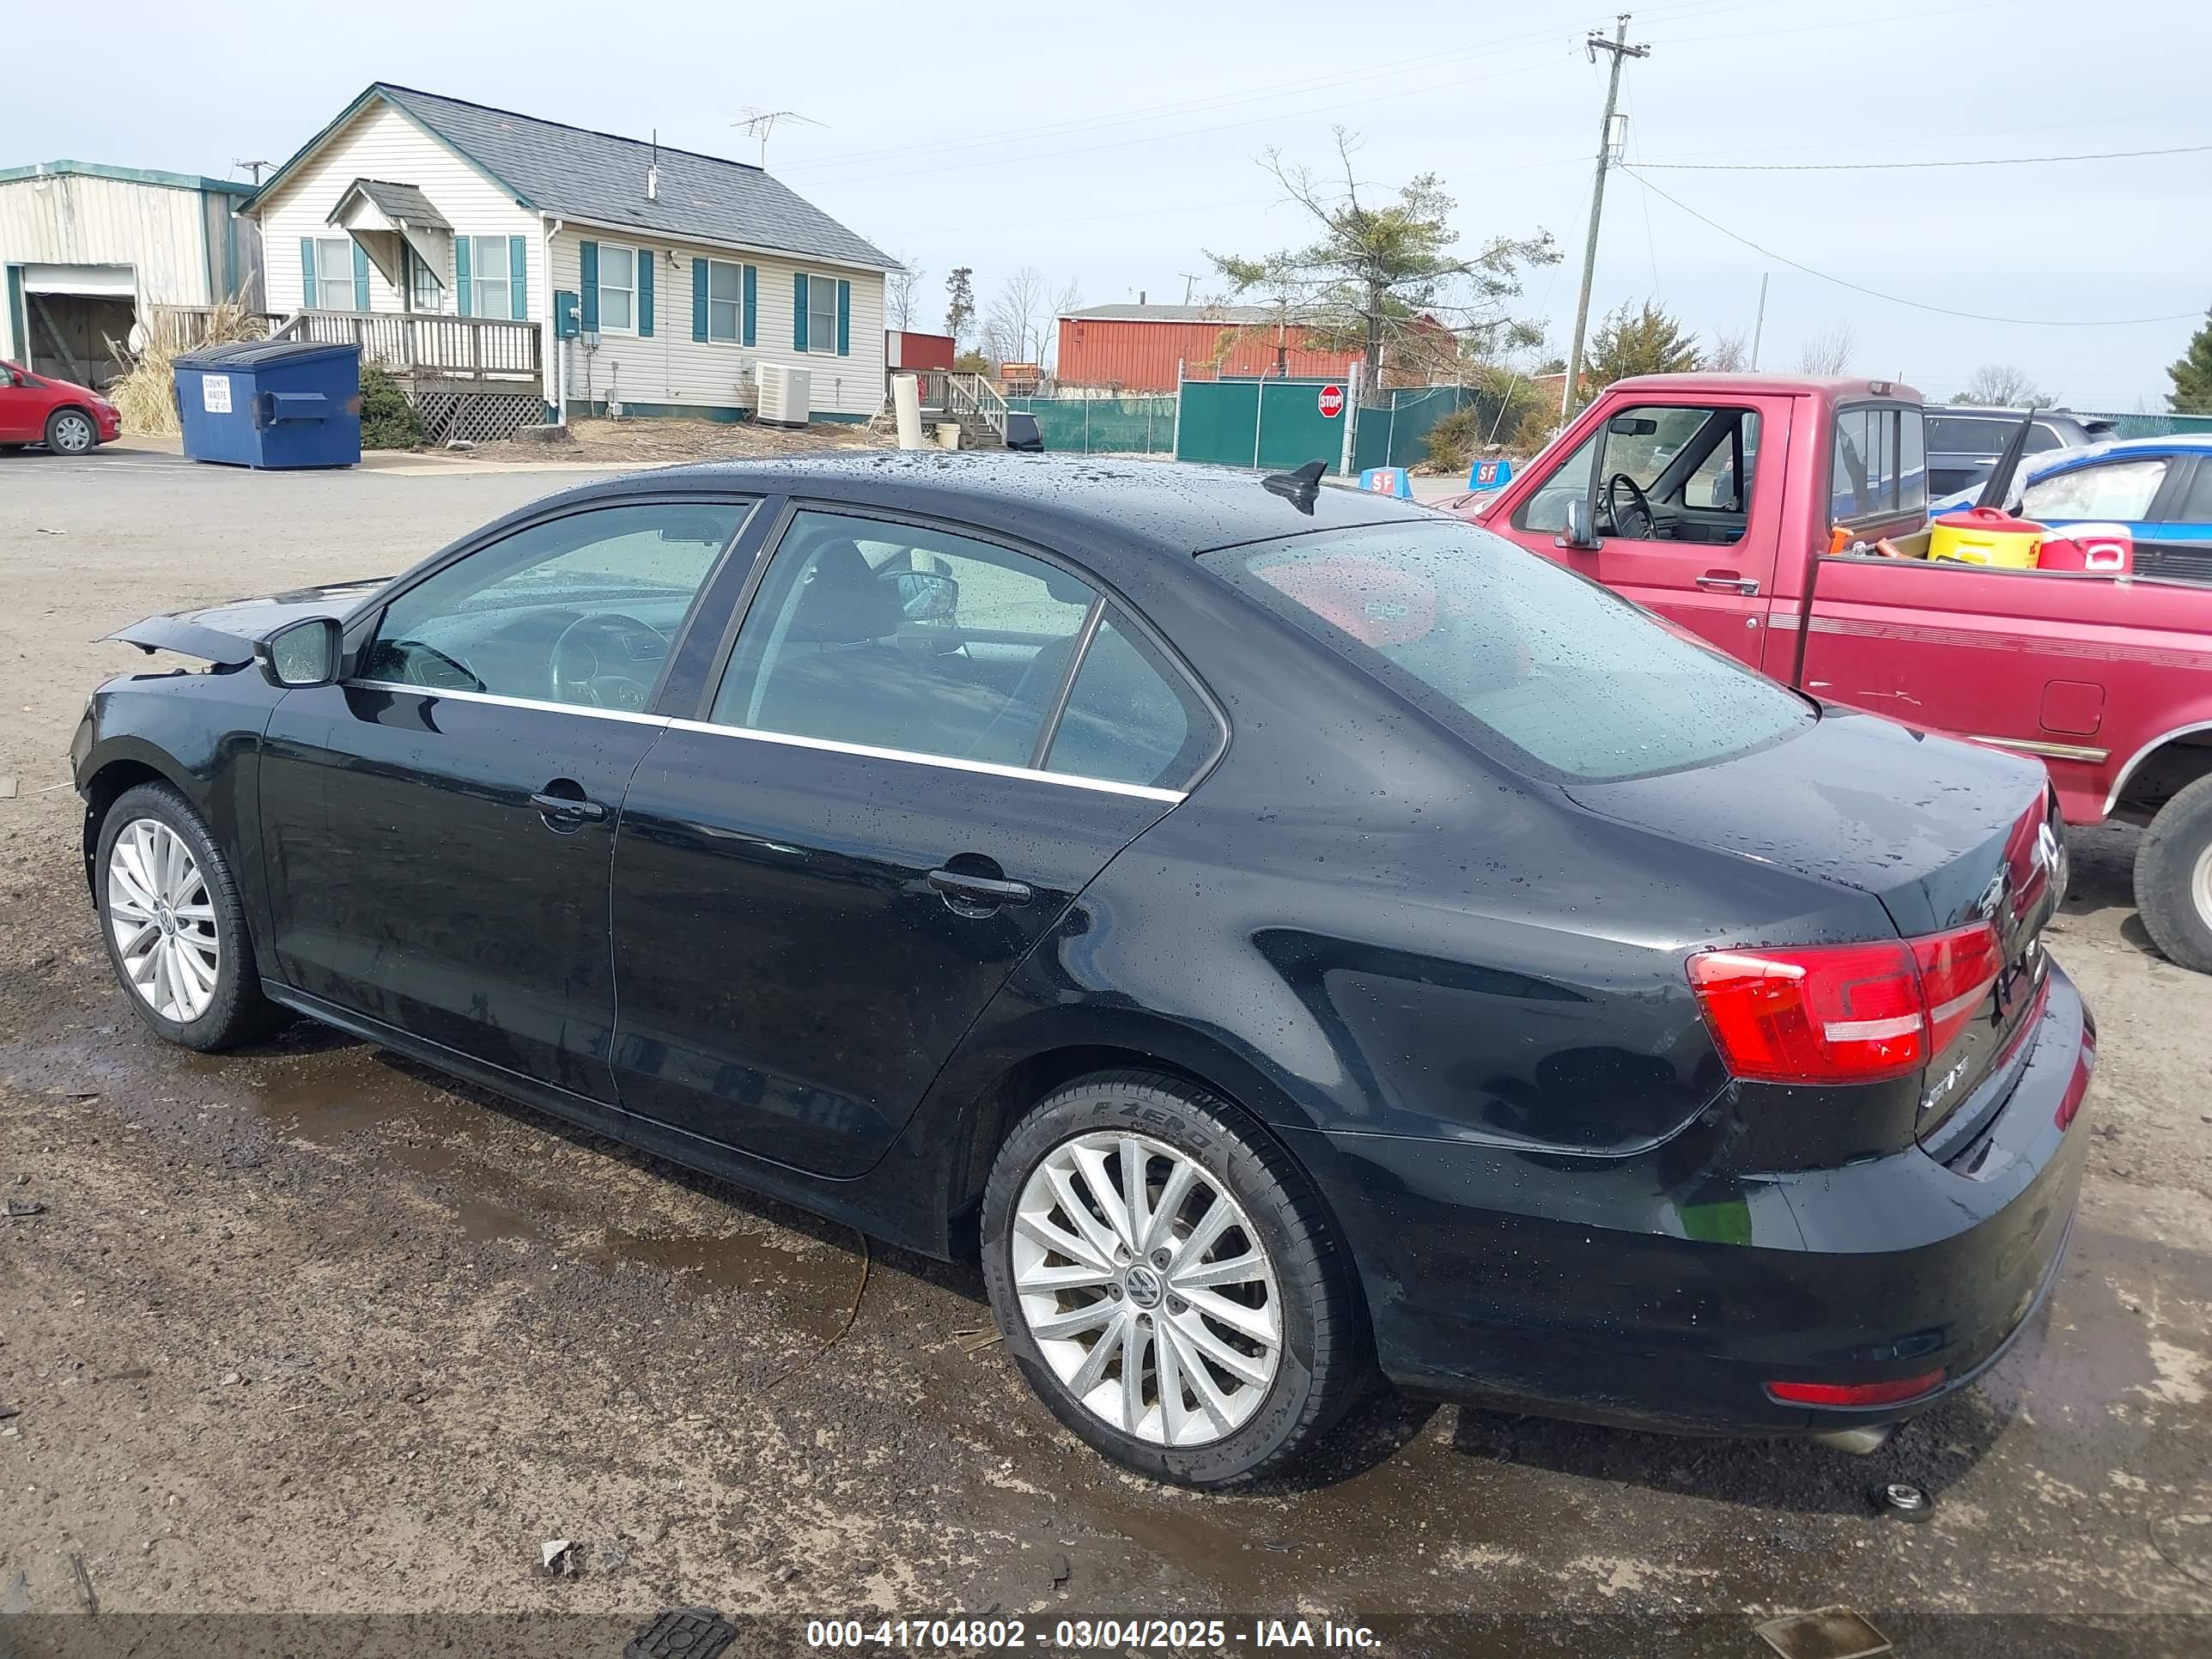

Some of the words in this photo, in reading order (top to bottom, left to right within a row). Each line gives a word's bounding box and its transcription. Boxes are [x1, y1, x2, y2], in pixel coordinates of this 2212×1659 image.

[205, 379, 228, 389] COUNTY
[207, 391, 228, 400] WASTE
[1320, 394, 1342, 409] STOP
